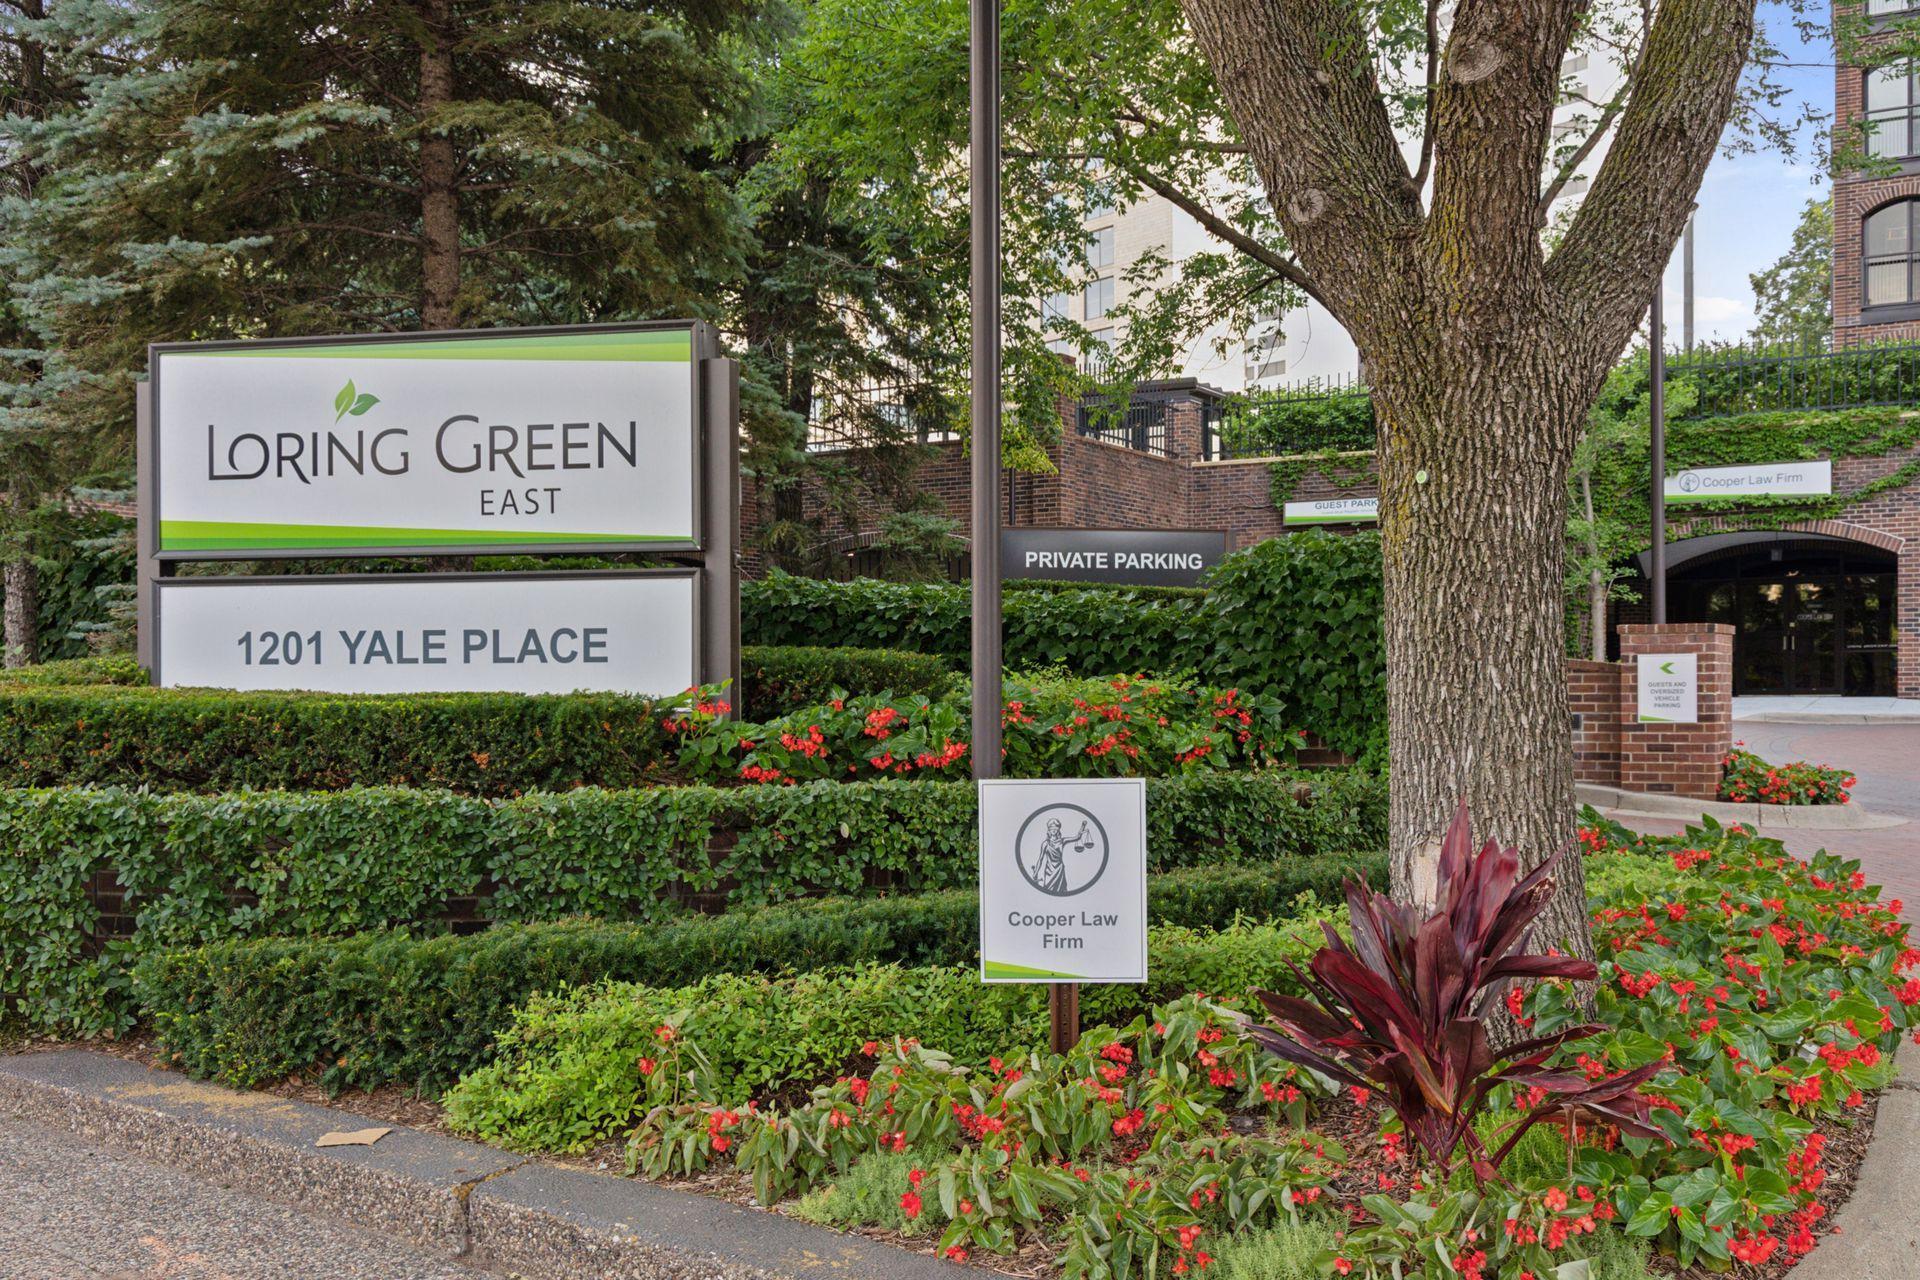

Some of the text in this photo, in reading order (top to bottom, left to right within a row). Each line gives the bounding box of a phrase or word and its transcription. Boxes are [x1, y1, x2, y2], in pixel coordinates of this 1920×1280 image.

[208, 415, 637, 485] LORING GREEN
[1703, 472, 1803, 488] Cooper Law Firm
[480, 488, 562, 516] EAST
[1314, 499, 1378, 510] GUEST PARK
[1025, 551, 1203, 570] PRIVATE PARKING
[237, 627, 609, 666] 1201 YALE PLACE
[1008, 911, 1118, 930] Cooper Law
[1043, 934, 1084, 949] Firm
